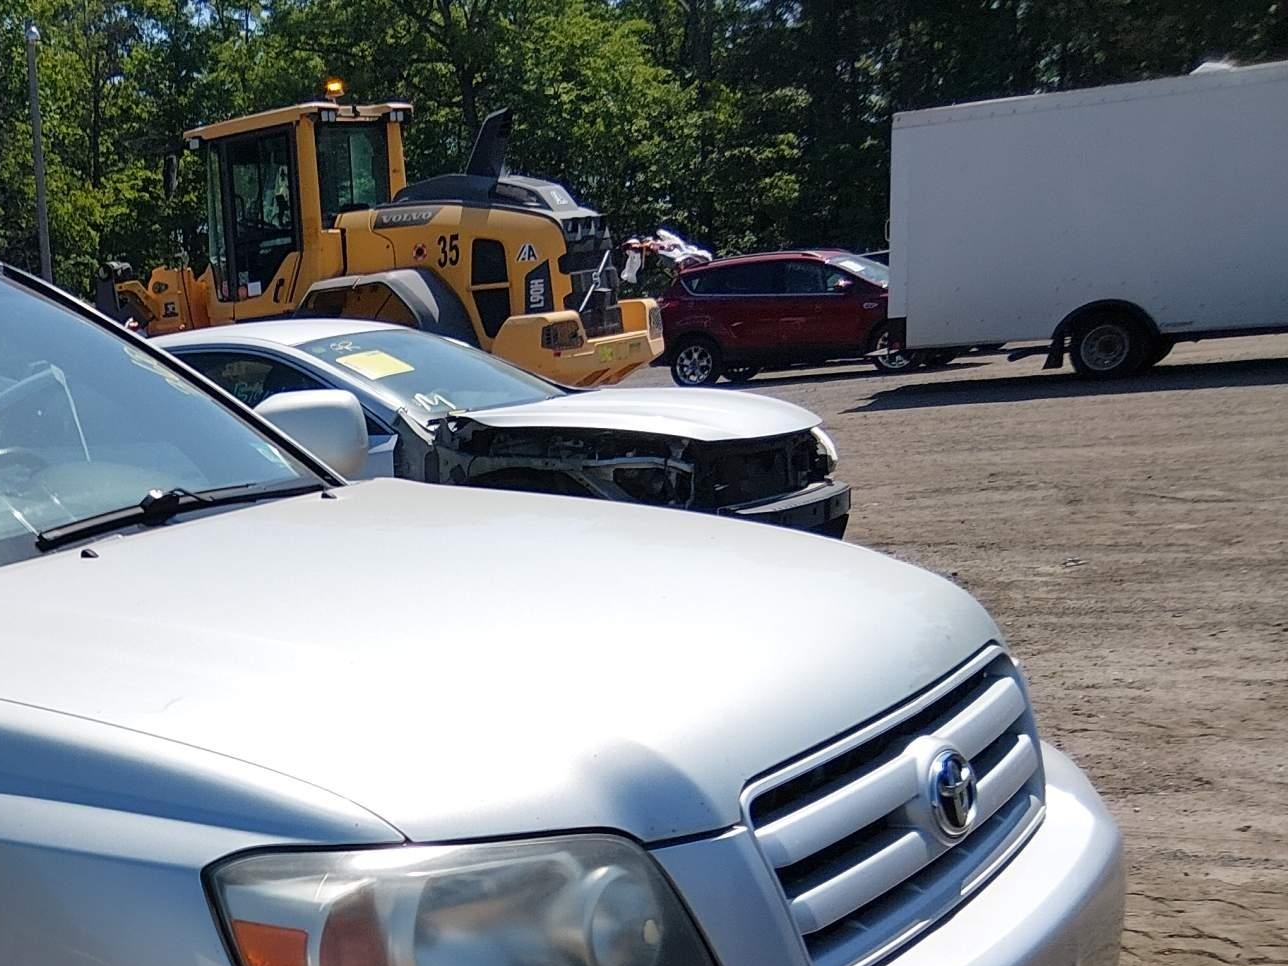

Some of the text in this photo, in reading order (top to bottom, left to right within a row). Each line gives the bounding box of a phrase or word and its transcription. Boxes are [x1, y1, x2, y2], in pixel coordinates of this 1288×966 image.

[382, 211, 432, 224] VOLVO
[437, 232, 460, 268] 35
[529, 279, 544, 308] L90H
